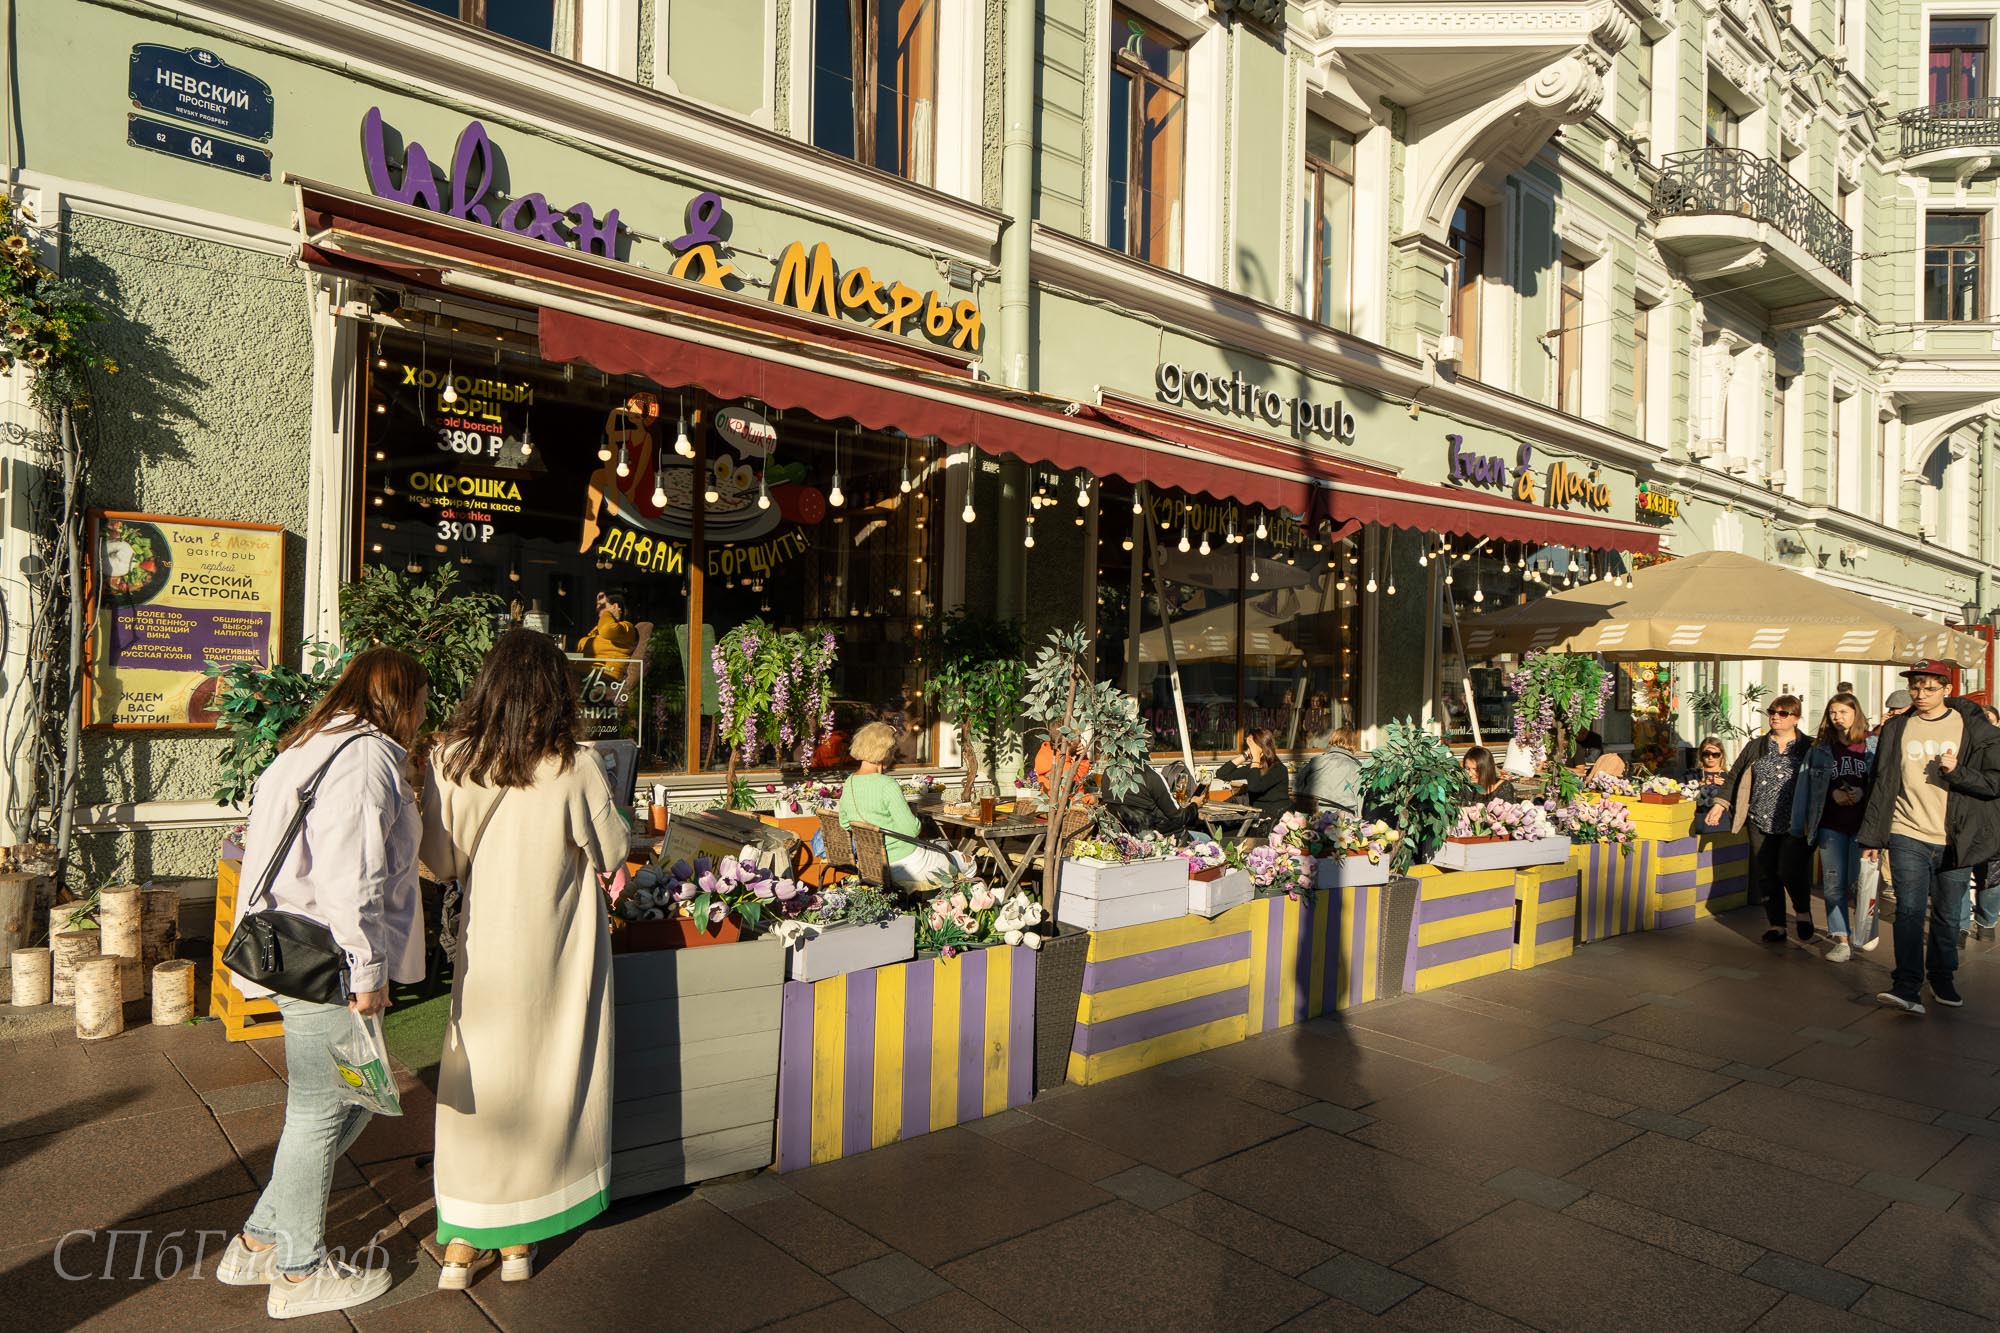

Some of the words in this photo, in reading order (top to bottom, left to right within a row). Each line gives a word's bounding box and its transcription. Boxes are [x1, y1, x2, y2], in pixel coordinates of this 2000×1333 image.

[156, 67, 249, 110] НЕВСКИЙ
[179, 93, 228, 115] ПРОСПЕКТ
[175, 106, 199, 118] NEVSKY
[199, 113, 229, 126] PROSPEKT
[156, 133, 166, 143] 62
[190, 136, 213, 159] 64
[361, 106, 620, 260] Иван
[772, 241, 983, 351] Марья
[1157, 361, 1283, 420] gastro
[1291, 398, 1356, 439] pub
[437, 393, 502, 422] БОРЩ
[435, 416, 461, 429] cold
[463, 418, 504, 434] borscht
[437, 428, 482, 455] 380
[1446, 434, 1507, 486] Ivan
[1546, 461, 1613, 508] Maria
[410, 471, 523, 501] ОКРОШКА
[490, 502, 522, 513] квасе
[1651, 493, 1680, 516] KRIEK
[441, 509, 493, 522] okroshka
[437, 520, 477, 542] 390
[172, 531, 203, 545] Ivan
[227, 536, 271, 550] Maria
[186, 547, 228, 558] gastro
[232, 551, 256, 561] pub
[597, 527, 687, 574] ДАВАЙ
[708, 526, 811, 578] БОРЩИТЬ!
[200, 562, 236, 573] первый
[180, 573, 253, 588] РУССКИЙ
[171, 585, 260, 601] ГАСТРОПАБ
[136, 610, 166, 619] БОЛЕЕ
[212, 616, 263, 625] ОБШИРНЫЙ
[118, 616, 154, 625] СОРТОВ
[155, 619, 198, 628] ПЕННОГО
[222, 623, 253, 631] ВЫБОР
[146, 632, 171, 640] ВИНА
[147, 625, 190, 634] ПОЗИЦИЙ
[214, 629, 259, 638] НАПИТКОВ
[121, 651, 162, 660] РУССКАЯ
[131, 645, 183, 653] АВТОРСКАЯ
[202, 647, 260, 656] СПОРТИВНЫЕ
[120, 692, 163, 703] ЖДЕМ
[128, 704, 155, 712] ВАС
[112, 714, 170, 723] ВНУТРИ!
